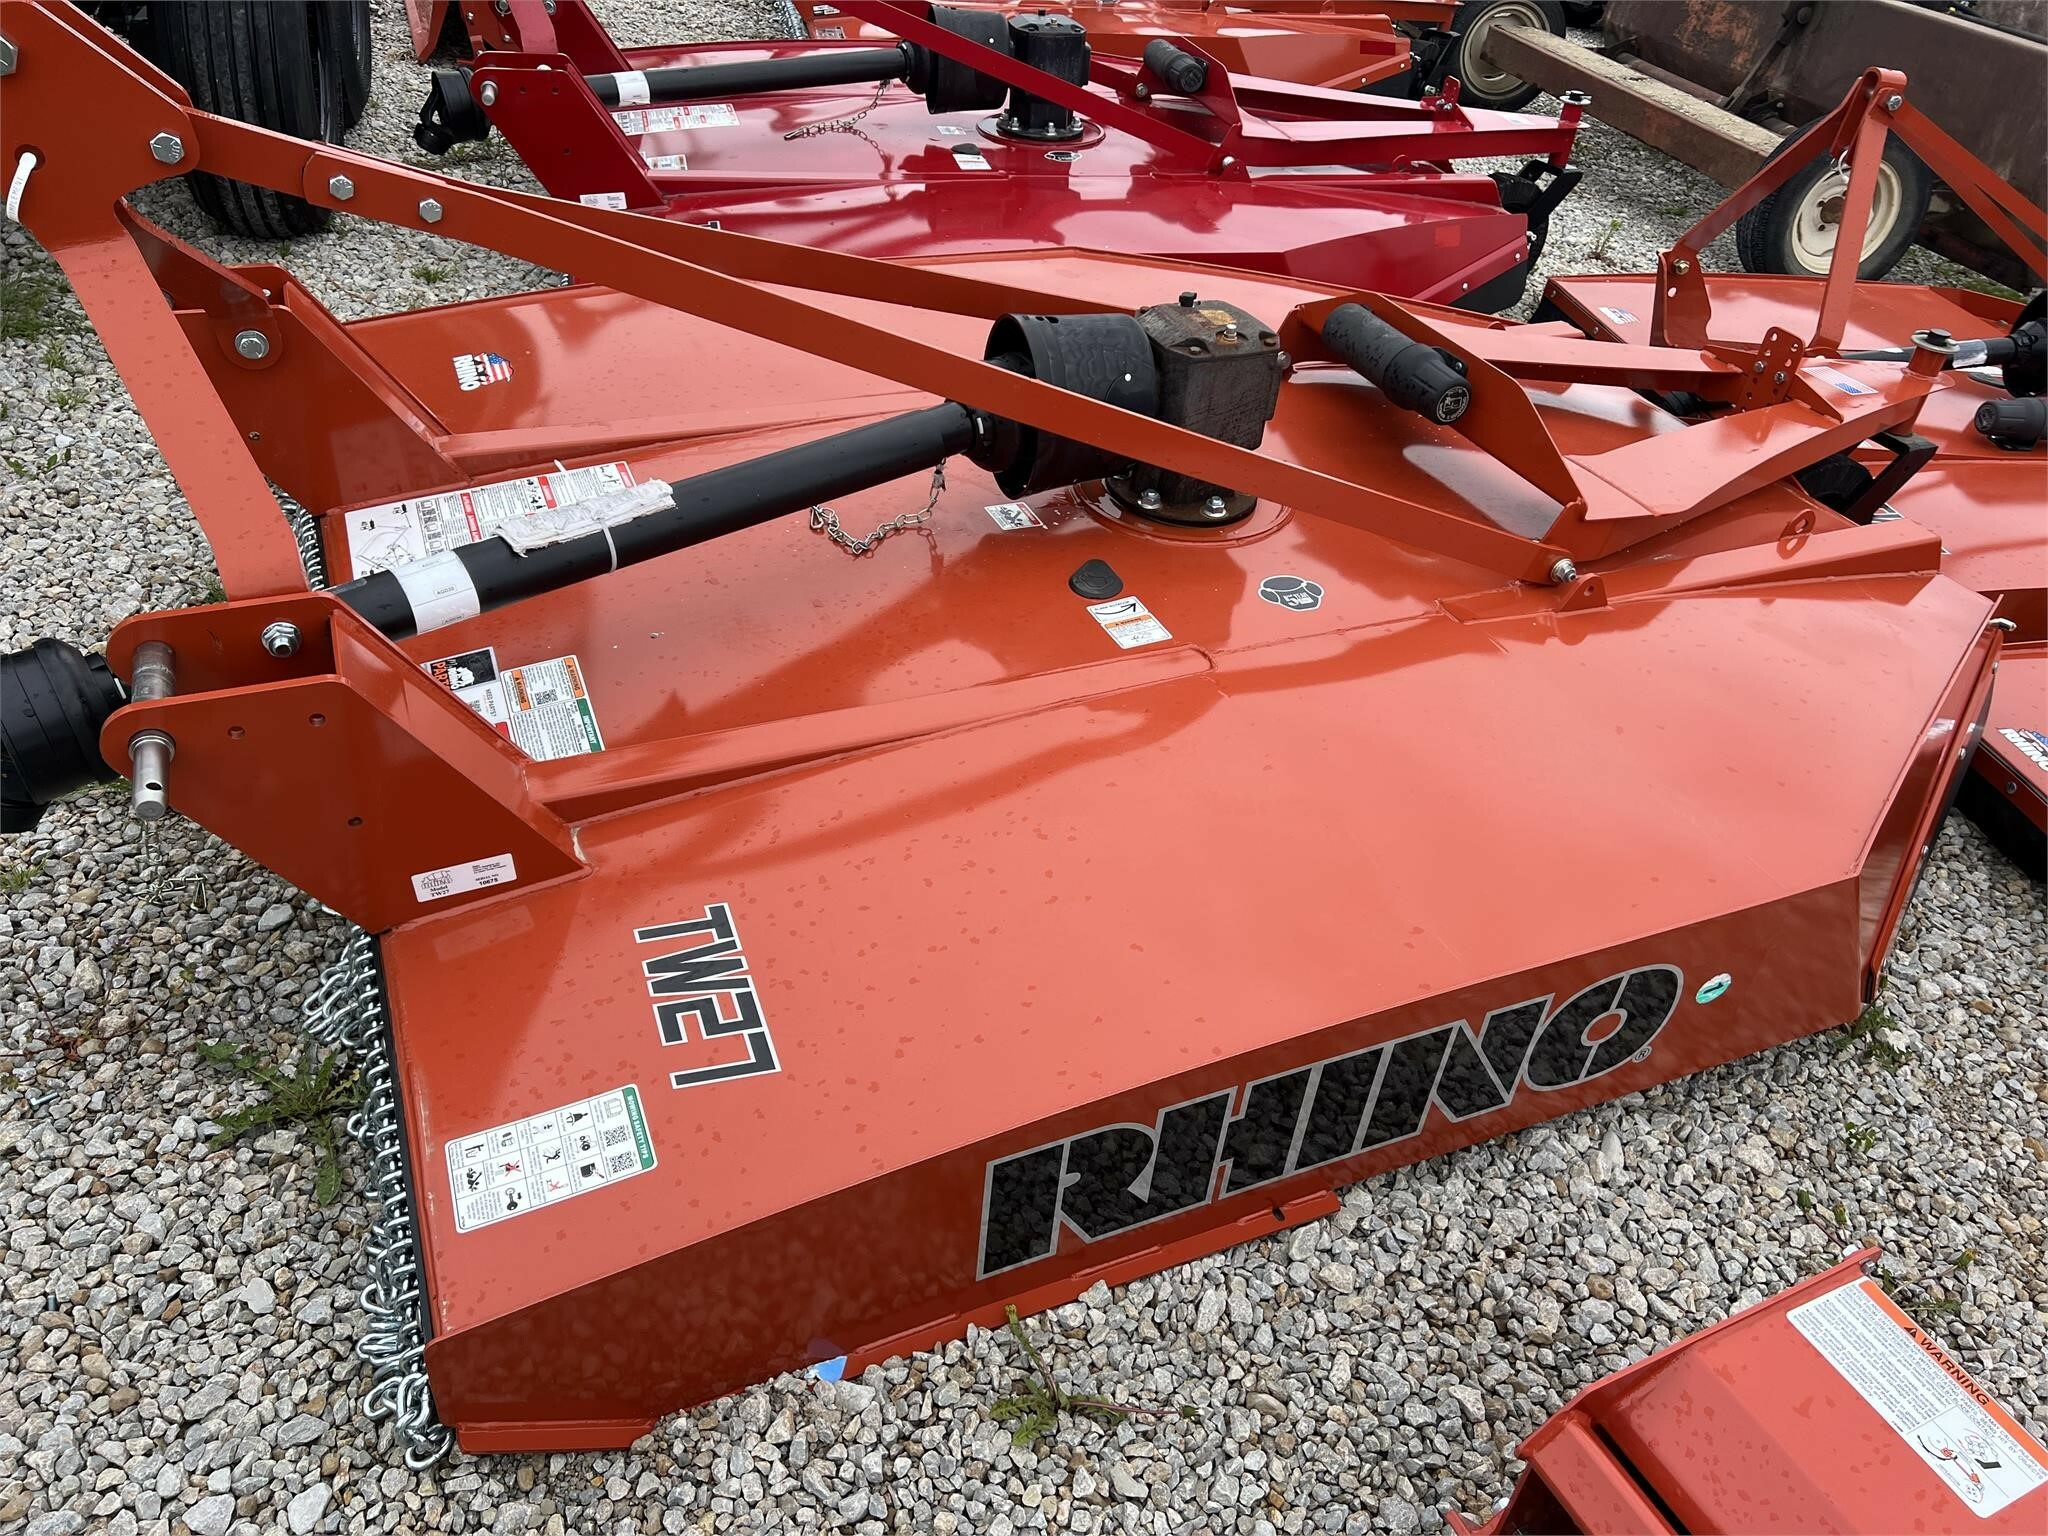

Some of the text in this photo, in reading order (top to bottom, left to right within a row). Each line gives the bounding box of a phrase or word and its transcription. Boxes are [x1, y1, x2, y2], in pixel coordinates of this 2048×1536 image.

[453, 354, 481, 391] RHINO
[581, 714, 597, 744] IMPORTANT
[431, 889, 450, 898] TW27
[633, 902, 782, 1089] TW27
[625, 1094, 649, 1159] MOWING SAFETY TIPS
[976, 964, 1683, 1281] RHINO
[1916, 1337, 1993, 1405] WARNING
